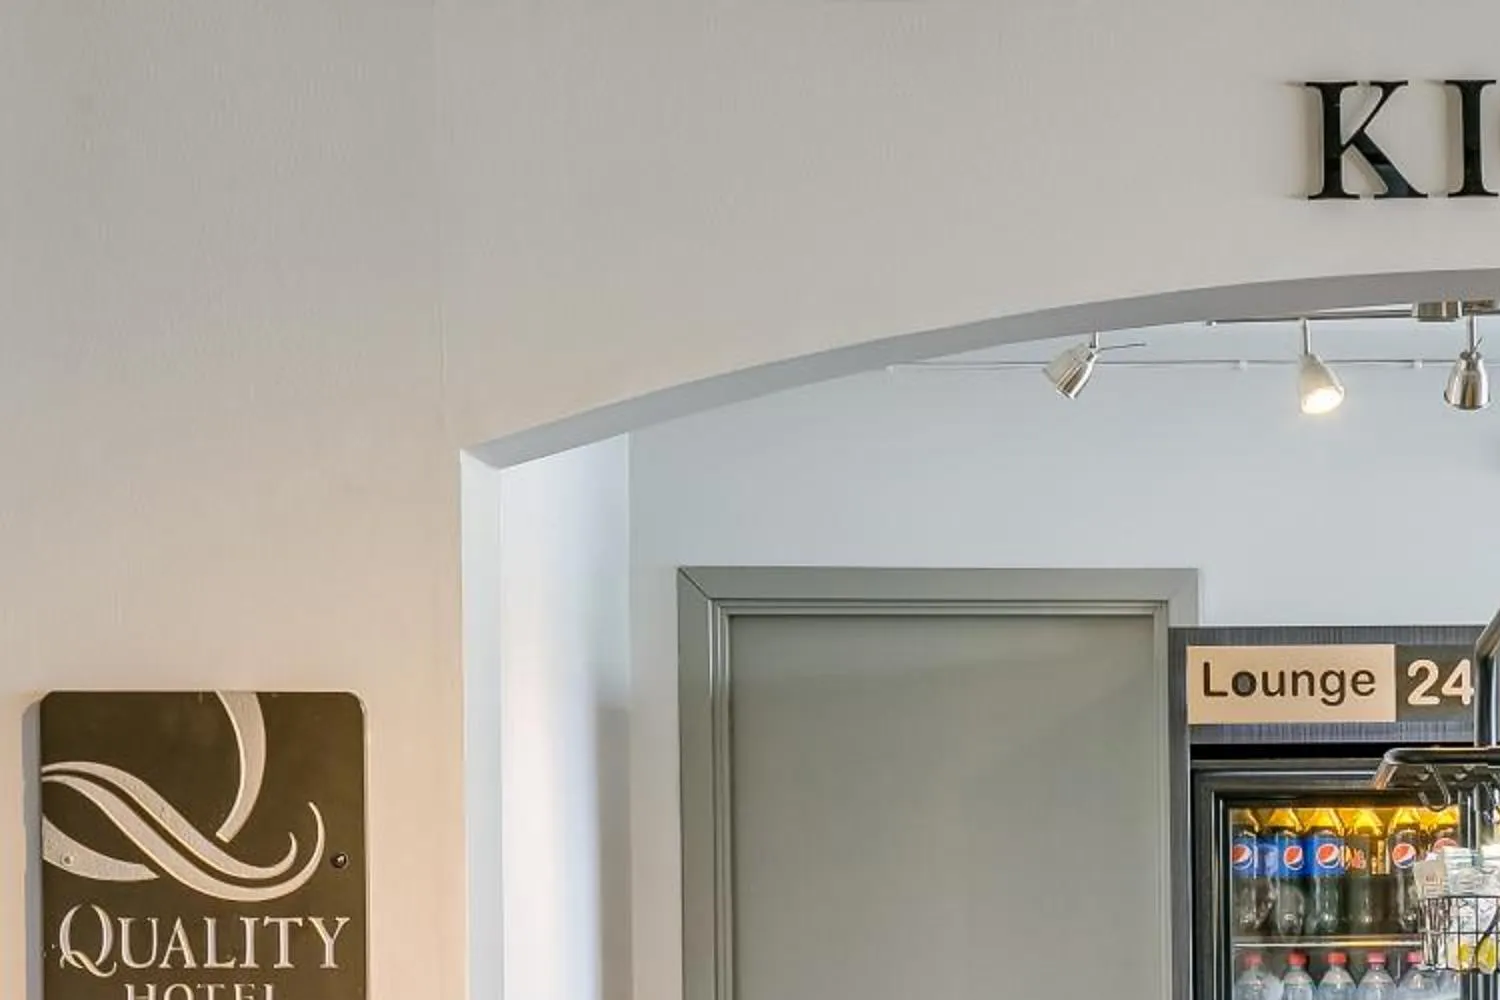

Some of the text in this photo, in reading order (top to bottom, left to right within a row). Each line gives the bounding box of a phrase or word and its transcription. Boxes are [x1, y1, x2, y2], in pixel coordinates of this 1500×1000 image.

[1202, 658, 1475, 707] Lounge 24
[58, 903, 351, 978] QUALITY
